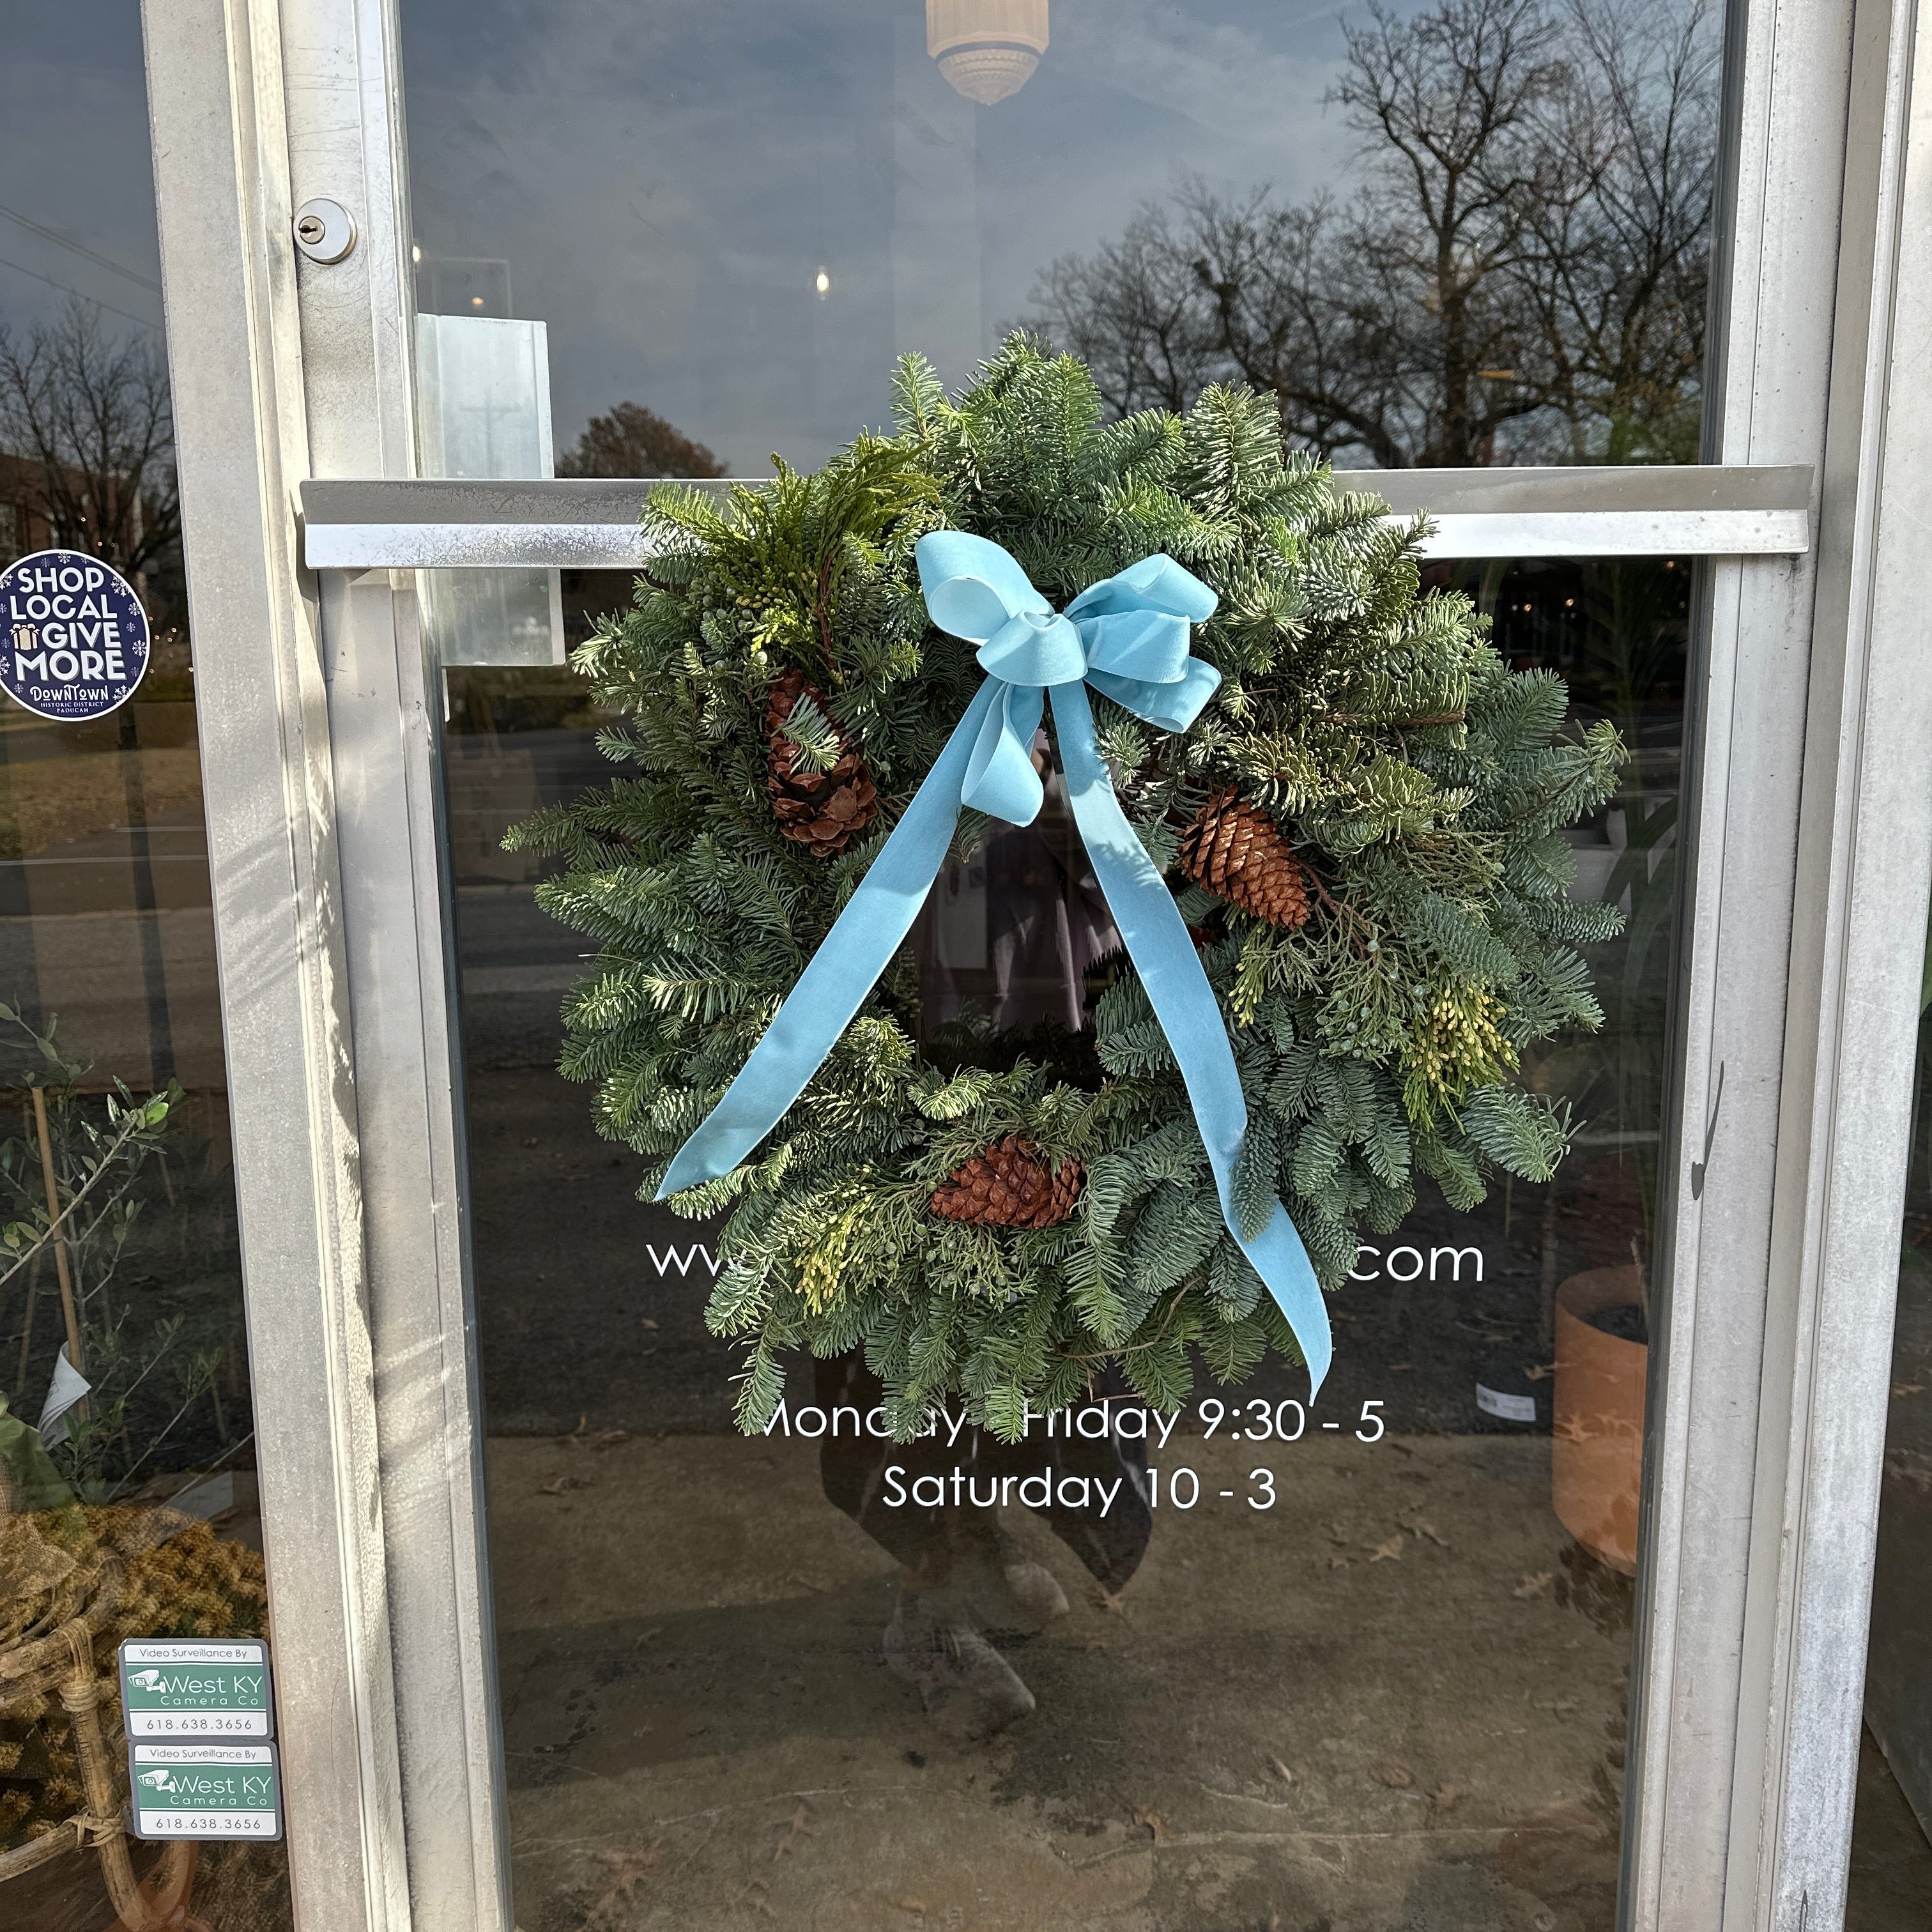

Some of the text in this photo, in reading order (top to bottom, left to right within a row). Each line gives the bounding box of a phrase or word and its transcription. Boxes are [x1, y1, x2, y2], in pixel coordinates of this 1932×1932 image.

[17, 567, 104, 594] SHOP
[10, 594, 118, 620] LOCAL
[42, 622, 122, 649] GIVE
[15, 650, 127, 682] MORE
[1023, 1398, 1181, 1448] Friday
[1199, 1398, 1306, 1441] 9:30
[1355, 1400, 1384, 1442] 5
[882, 1466, 1123, 1517] Saturday
[1146, 1468, 1200, 1509] 10
[1247, 1468, 1276, 1510] 3
[139, 1648, 247, 1659] Video Surveillance By
[163, 1675, 263, 1693] West KY
[160, 1696, 258, 1706] Camera Co
[147, 1719, 252, 1729] 618.638.3656
[150, 1749, 256, 1759] Video Surveillance By
[172, 1775, 272, 1793] West KY
[170, 1795, 267, 1805] Camera Co
[156, 1818, 261, 1829] 618.638.3656
